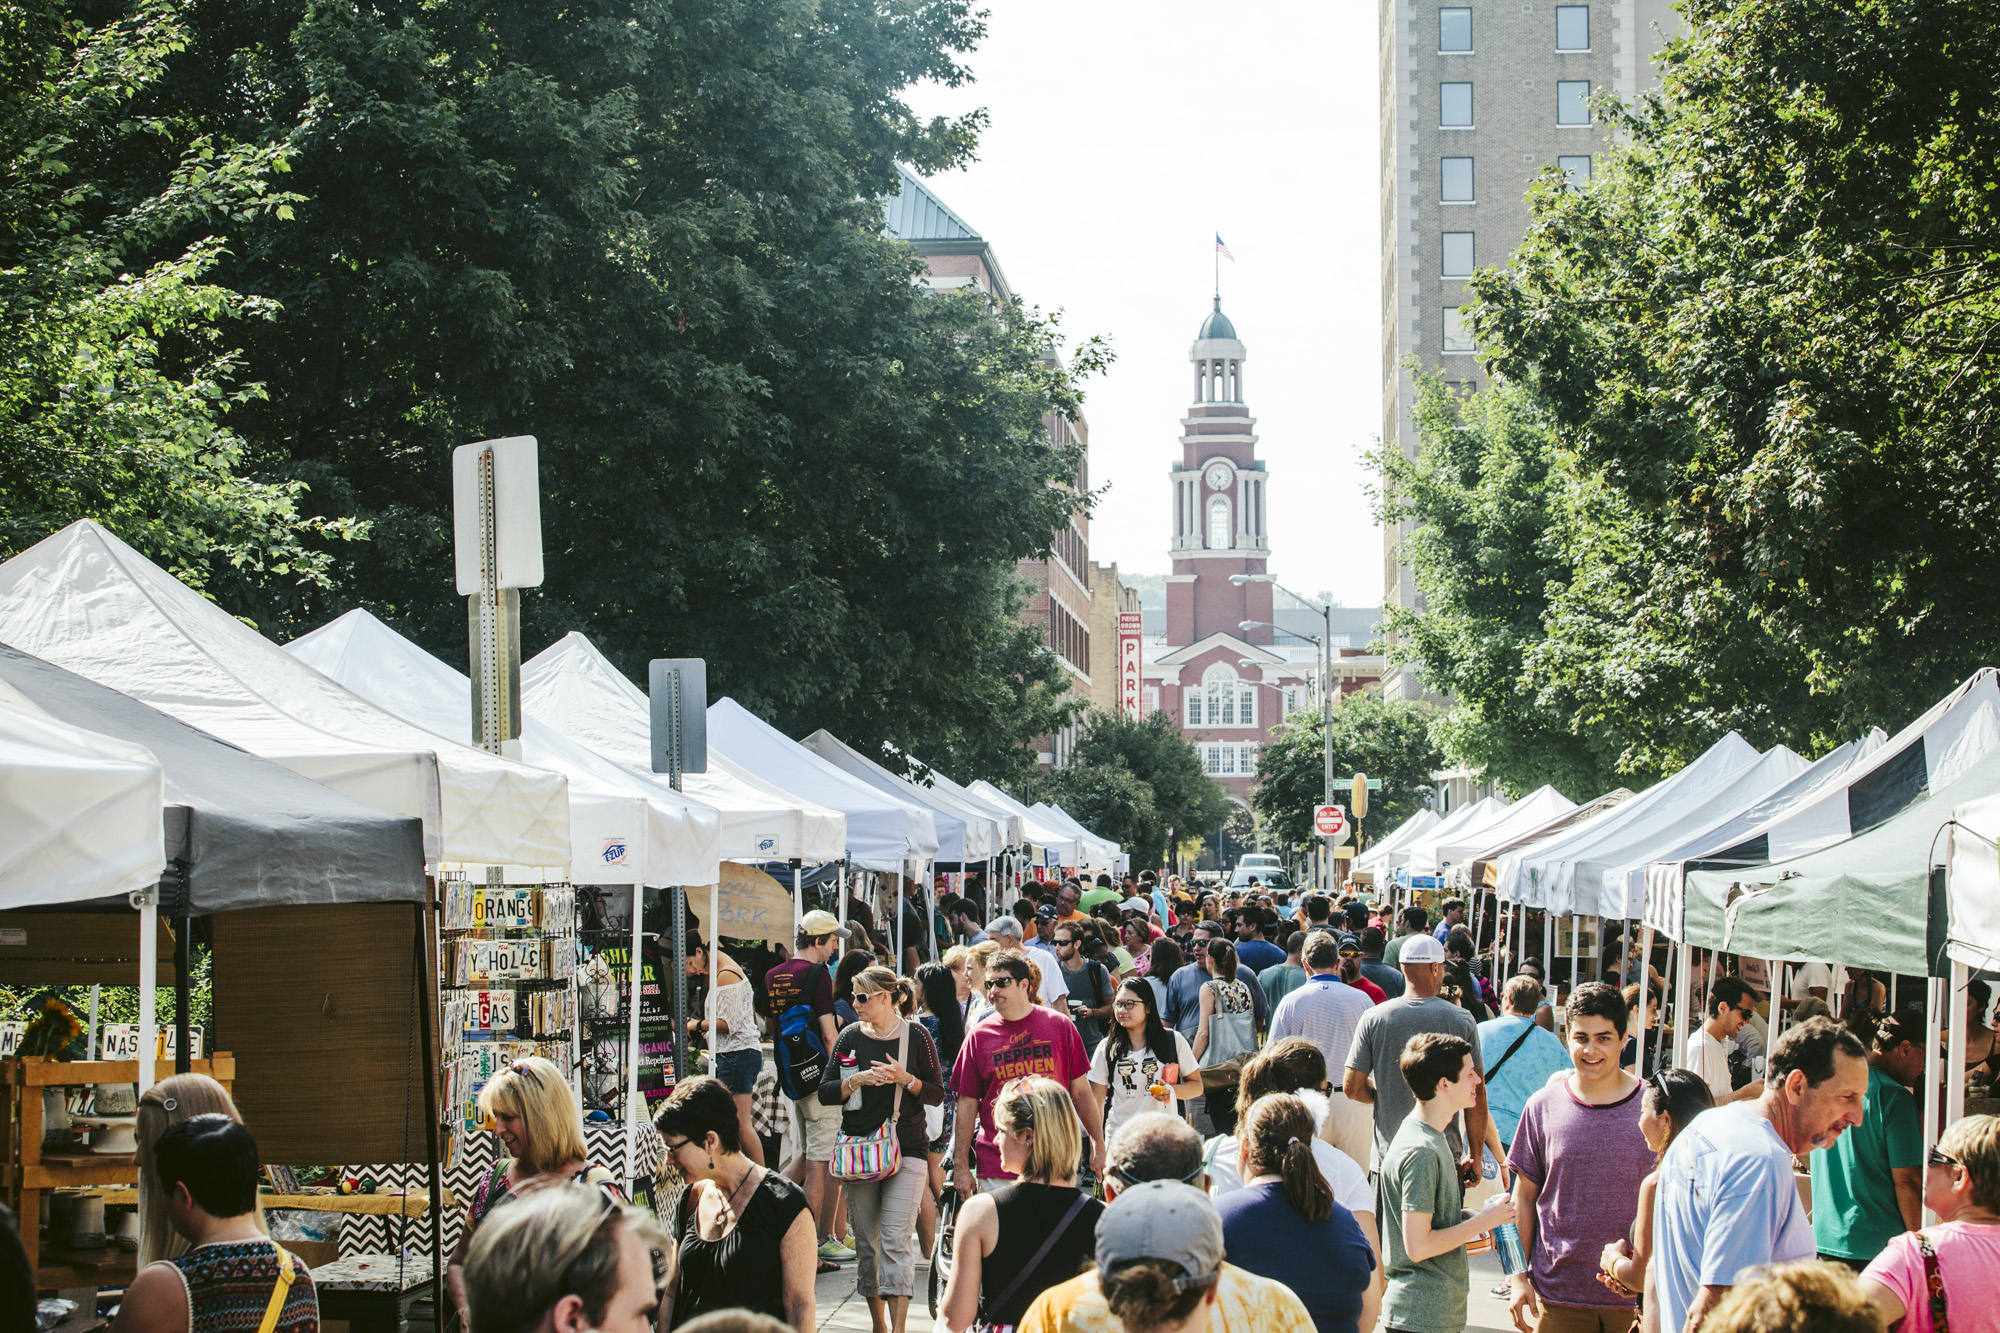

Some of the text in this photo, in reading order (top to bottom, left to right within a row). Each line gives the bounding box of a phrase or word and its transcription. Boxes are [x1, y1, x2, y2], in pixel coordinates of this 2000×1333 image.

[1334, 780, 1352, 788] Clinc
[718, 881, 760, 900] OCAL
[601, 947, 643, 966] SHE
[642, 984, 660, 995] SHELL
[640, 1014, 669, 1023] PROPERTIES
[638, 1041, 673, 1055] RGANIC
[645, 1055, 674, 1067] Repellent
[993, 1045, 1053, 1066] PEPPER
[995, 1058, 1055, 1079] HEAVEN
[644, 1088, 674, 1098] ADIN
